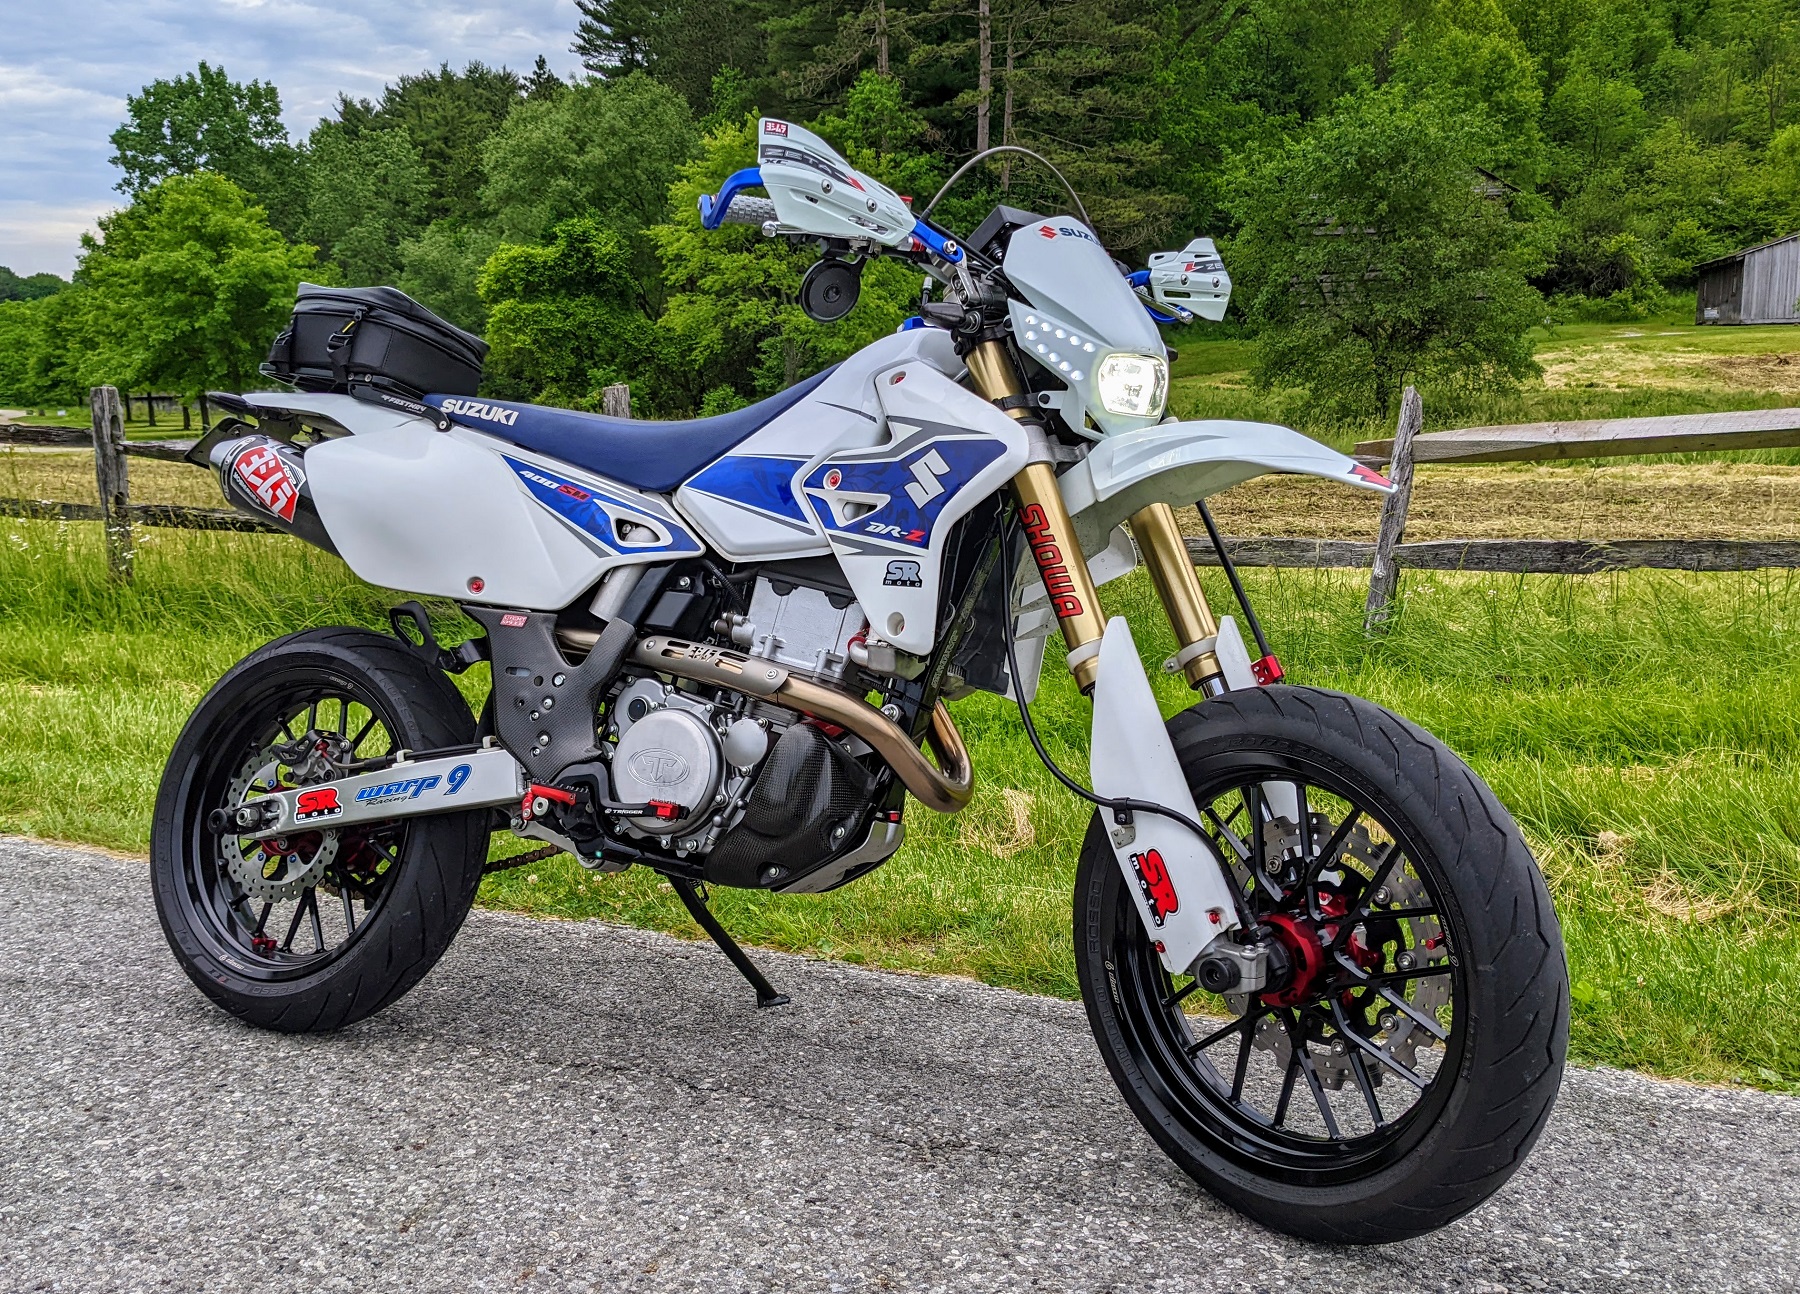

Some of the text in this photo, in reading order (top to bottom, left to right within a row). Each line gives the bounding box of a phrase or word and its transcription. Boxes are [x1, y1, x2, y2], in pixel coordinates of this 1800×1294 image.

[440, 398, 520, 427] SUZUKI
[238, 449, 294, 513] ヨシムラ
[864, 521, 926, 543] DR-Z
[886, 560, 921, 582] SR
[1018, 503, 1084, 618] SHOWA
[884, 579, 921, 588] moto
[355, 763, 473, 802] warp 9
[296, 807, 341, 820] moto
[297, 787, 341, 814] SR
[365, 795, 408, 808] Racing
[612, 808, 644, 816] TRIGGER
[1131, 855, 1163, 926] moto
[1137, 848, 1179, 921] SR
